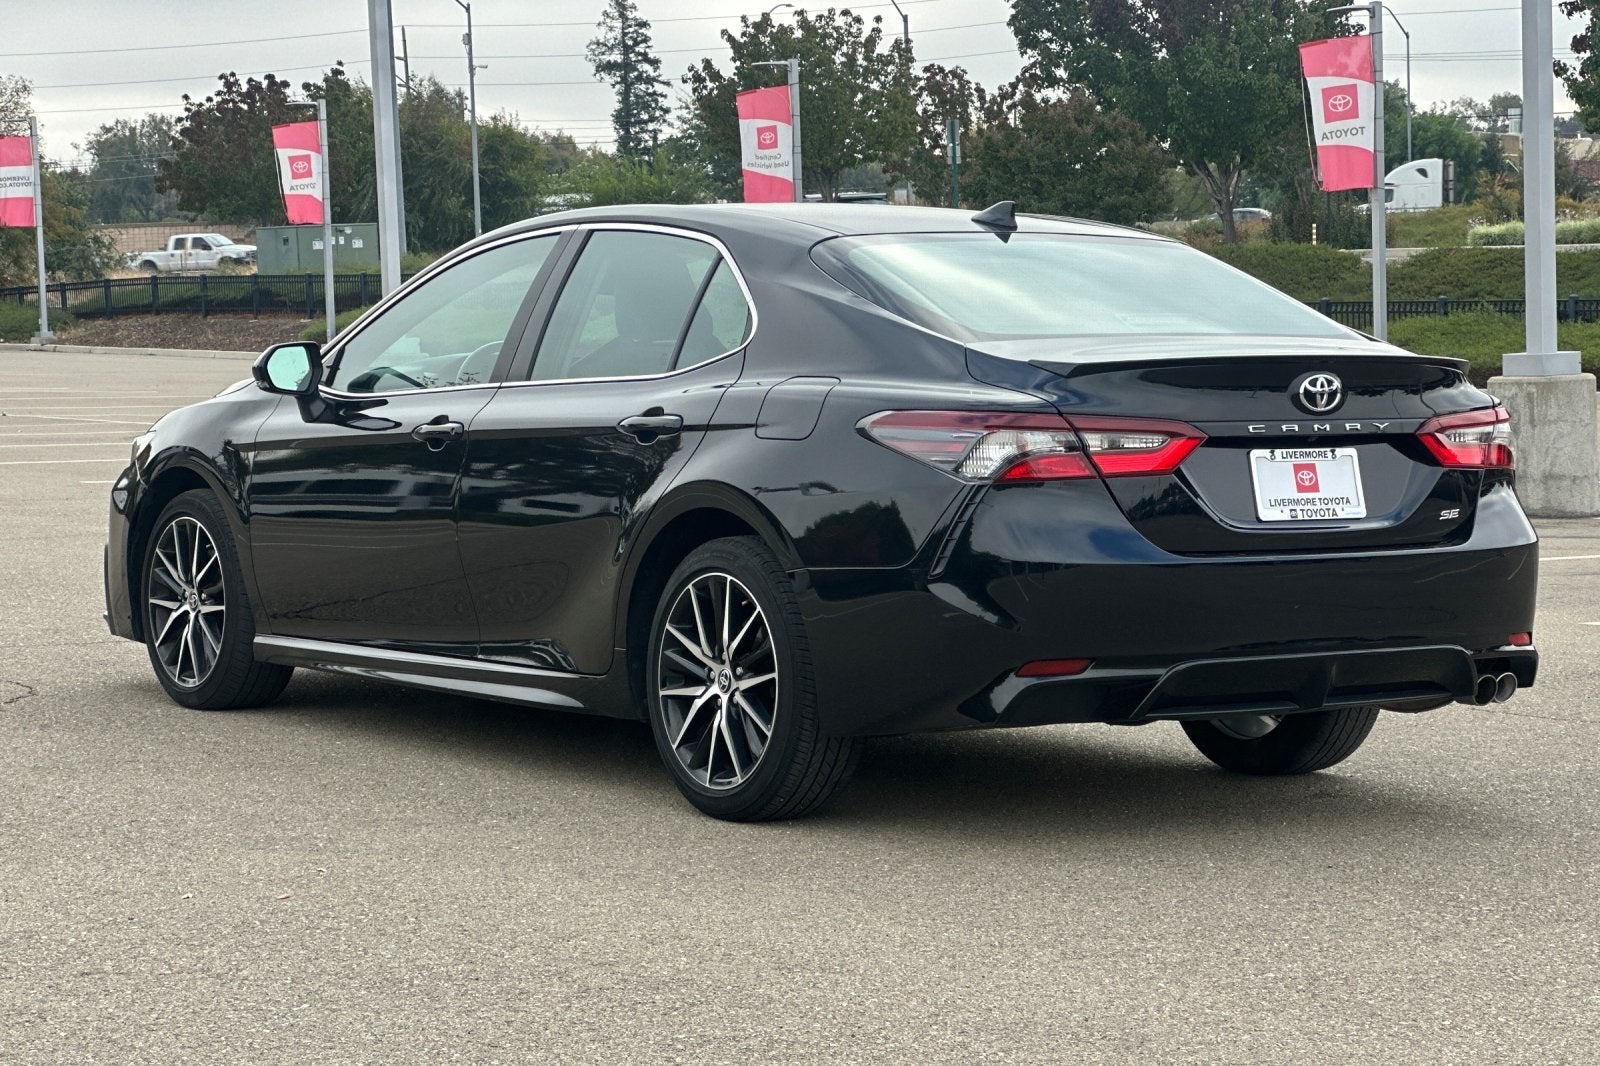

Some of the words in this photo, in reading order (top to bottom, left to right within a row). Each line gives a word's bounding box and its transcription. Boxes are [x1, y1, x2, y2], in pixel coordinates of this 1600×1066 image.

[1248, 422, 1390, 433] CAMRY
[1281, 450, 1329, 460] LIVERMORE
[1268, 497, 1318, 508] LIVERMORE
[1318, 496, 1352, 507] TOYOTA
[1299, 508, 1339, 519] TOYOTA
[1439, 508, 1460, 521] SE
